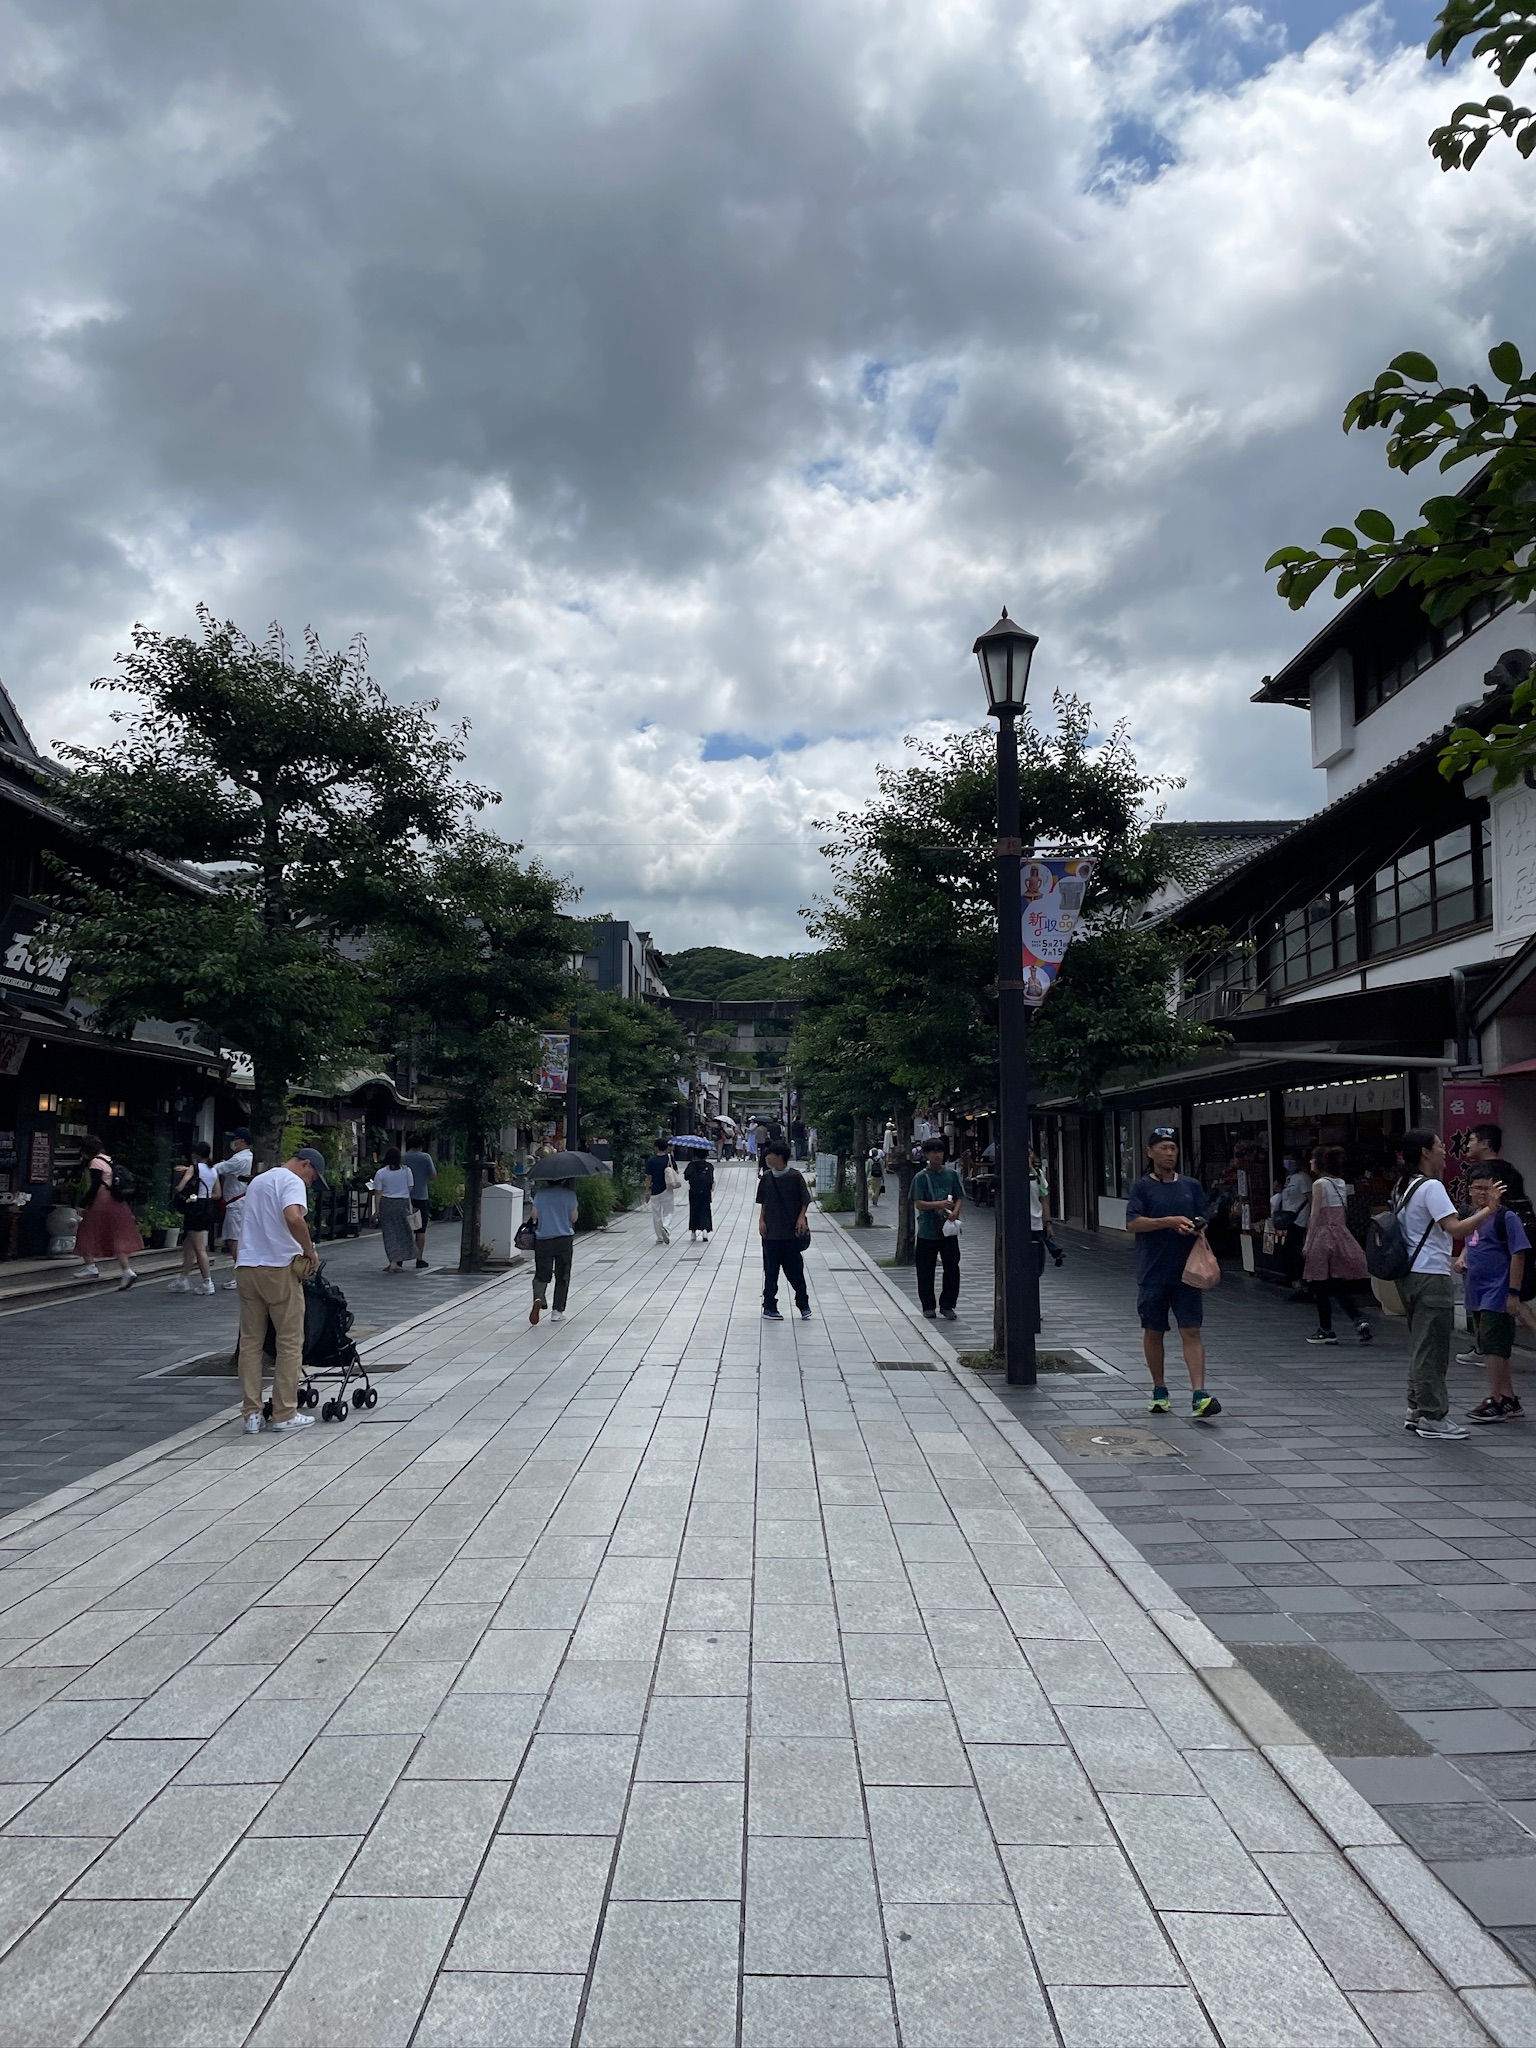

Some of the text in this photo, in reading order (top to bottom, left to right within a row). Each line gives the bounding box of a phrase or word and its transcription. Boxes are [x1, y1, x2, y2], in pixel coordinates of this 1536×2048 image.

[1028, 911, 1077, 937] 新収品
[1450, 1099, 1492, 1115] 名物
